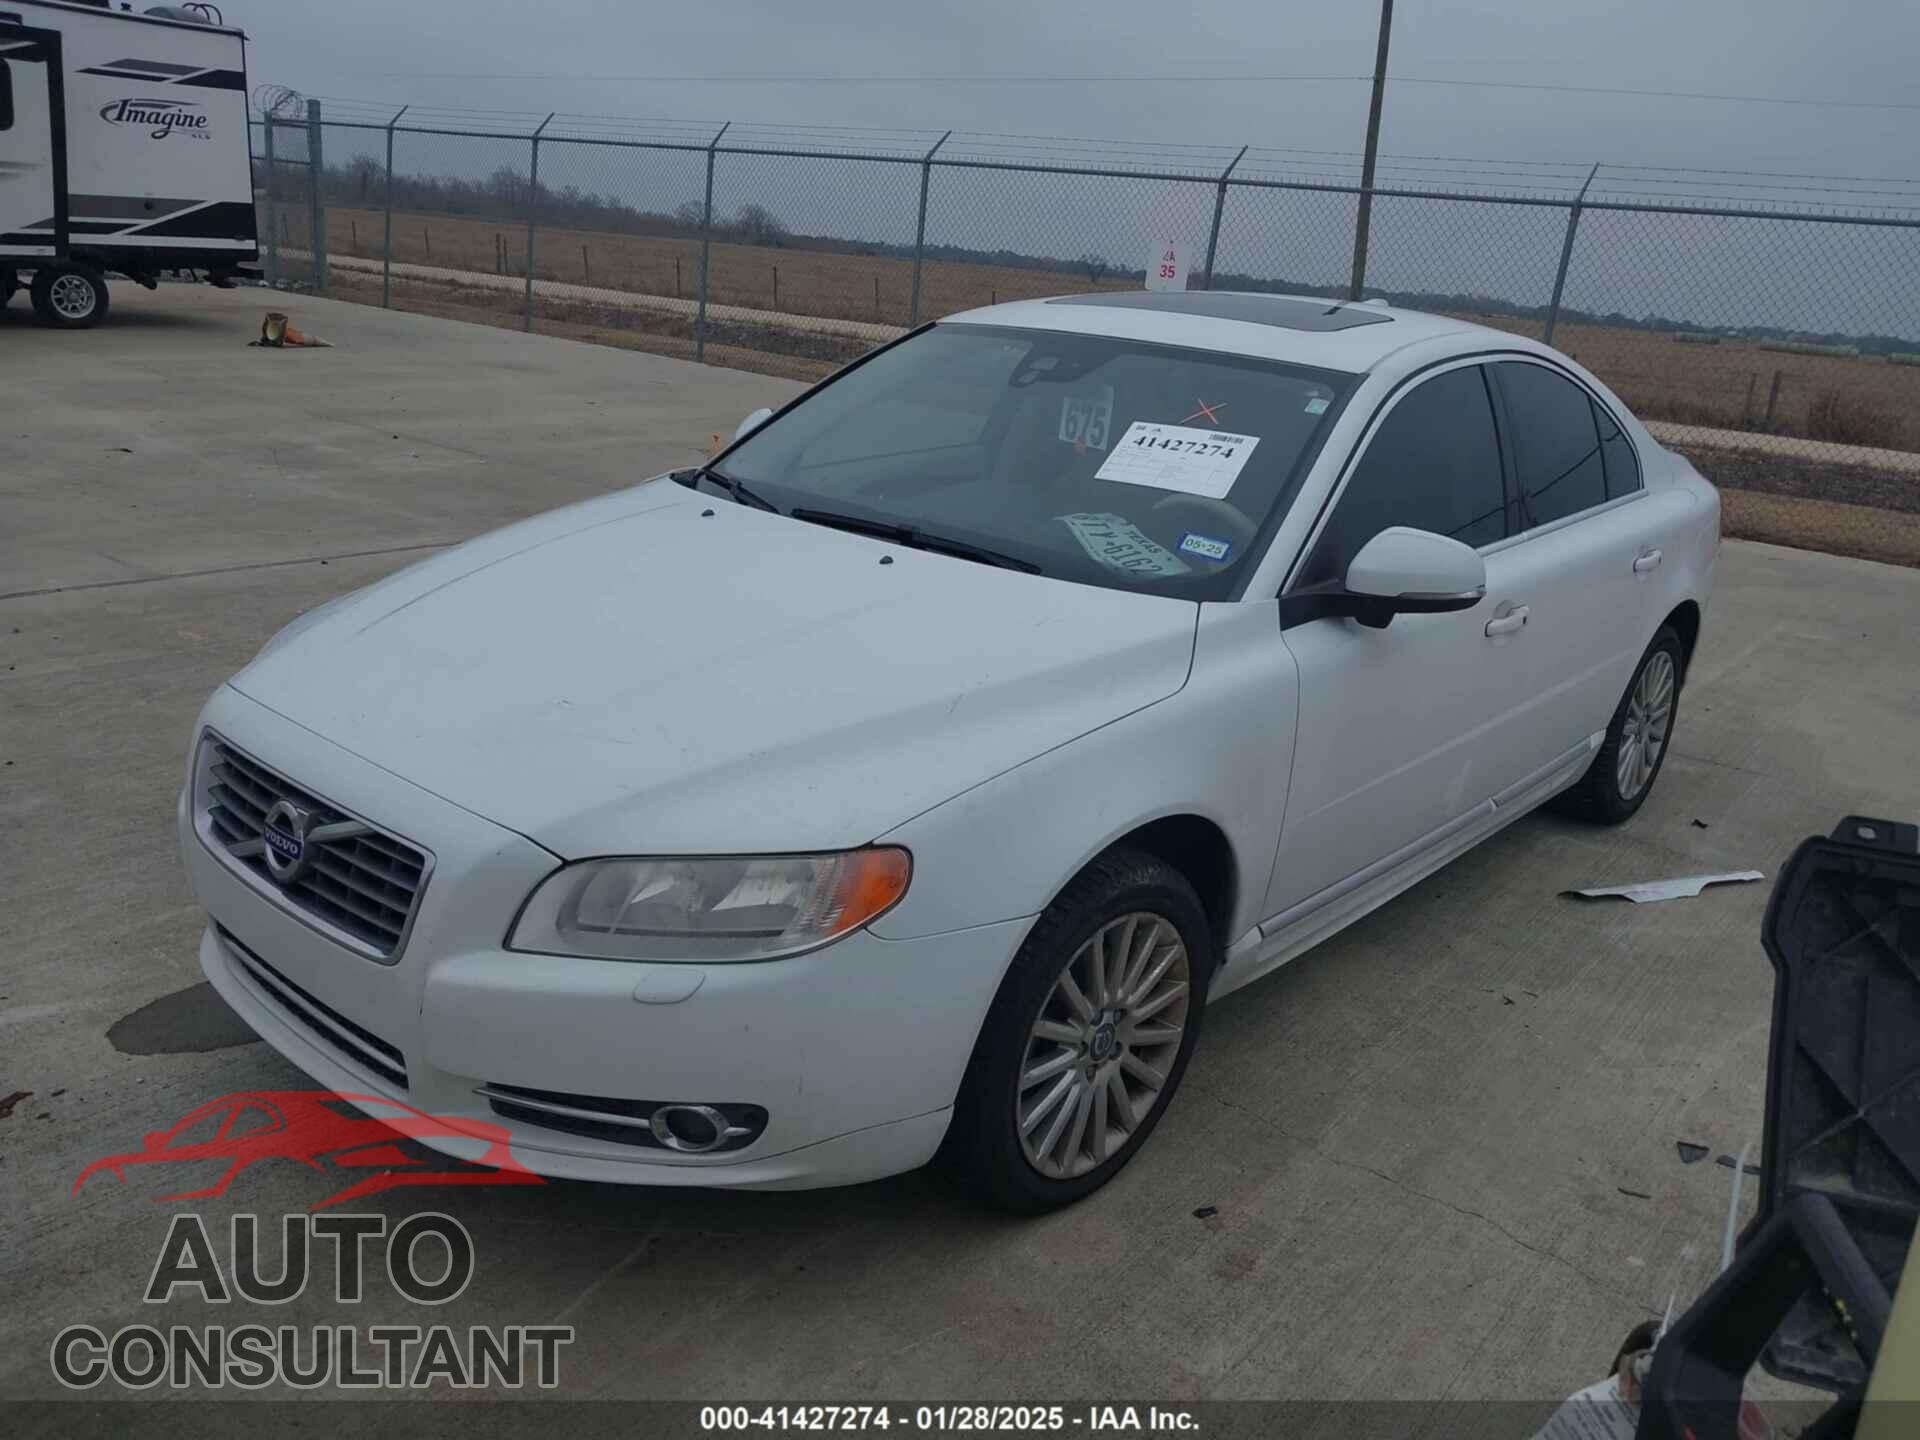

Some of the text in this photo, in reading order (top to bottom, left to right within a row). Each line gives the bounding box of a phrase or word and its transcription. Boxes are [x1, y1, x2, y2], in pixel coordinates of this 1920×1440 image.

[112, 98, 208, 139] Imagine
[1159, 264, 1176, 279] 35
[1065, 403, 1105, 446] 675
[1133, 436, 1235, 459] 41427274
[1124, 530, 1163, 554] TEXAS
[264, 828, 299, 855] VOLVO
